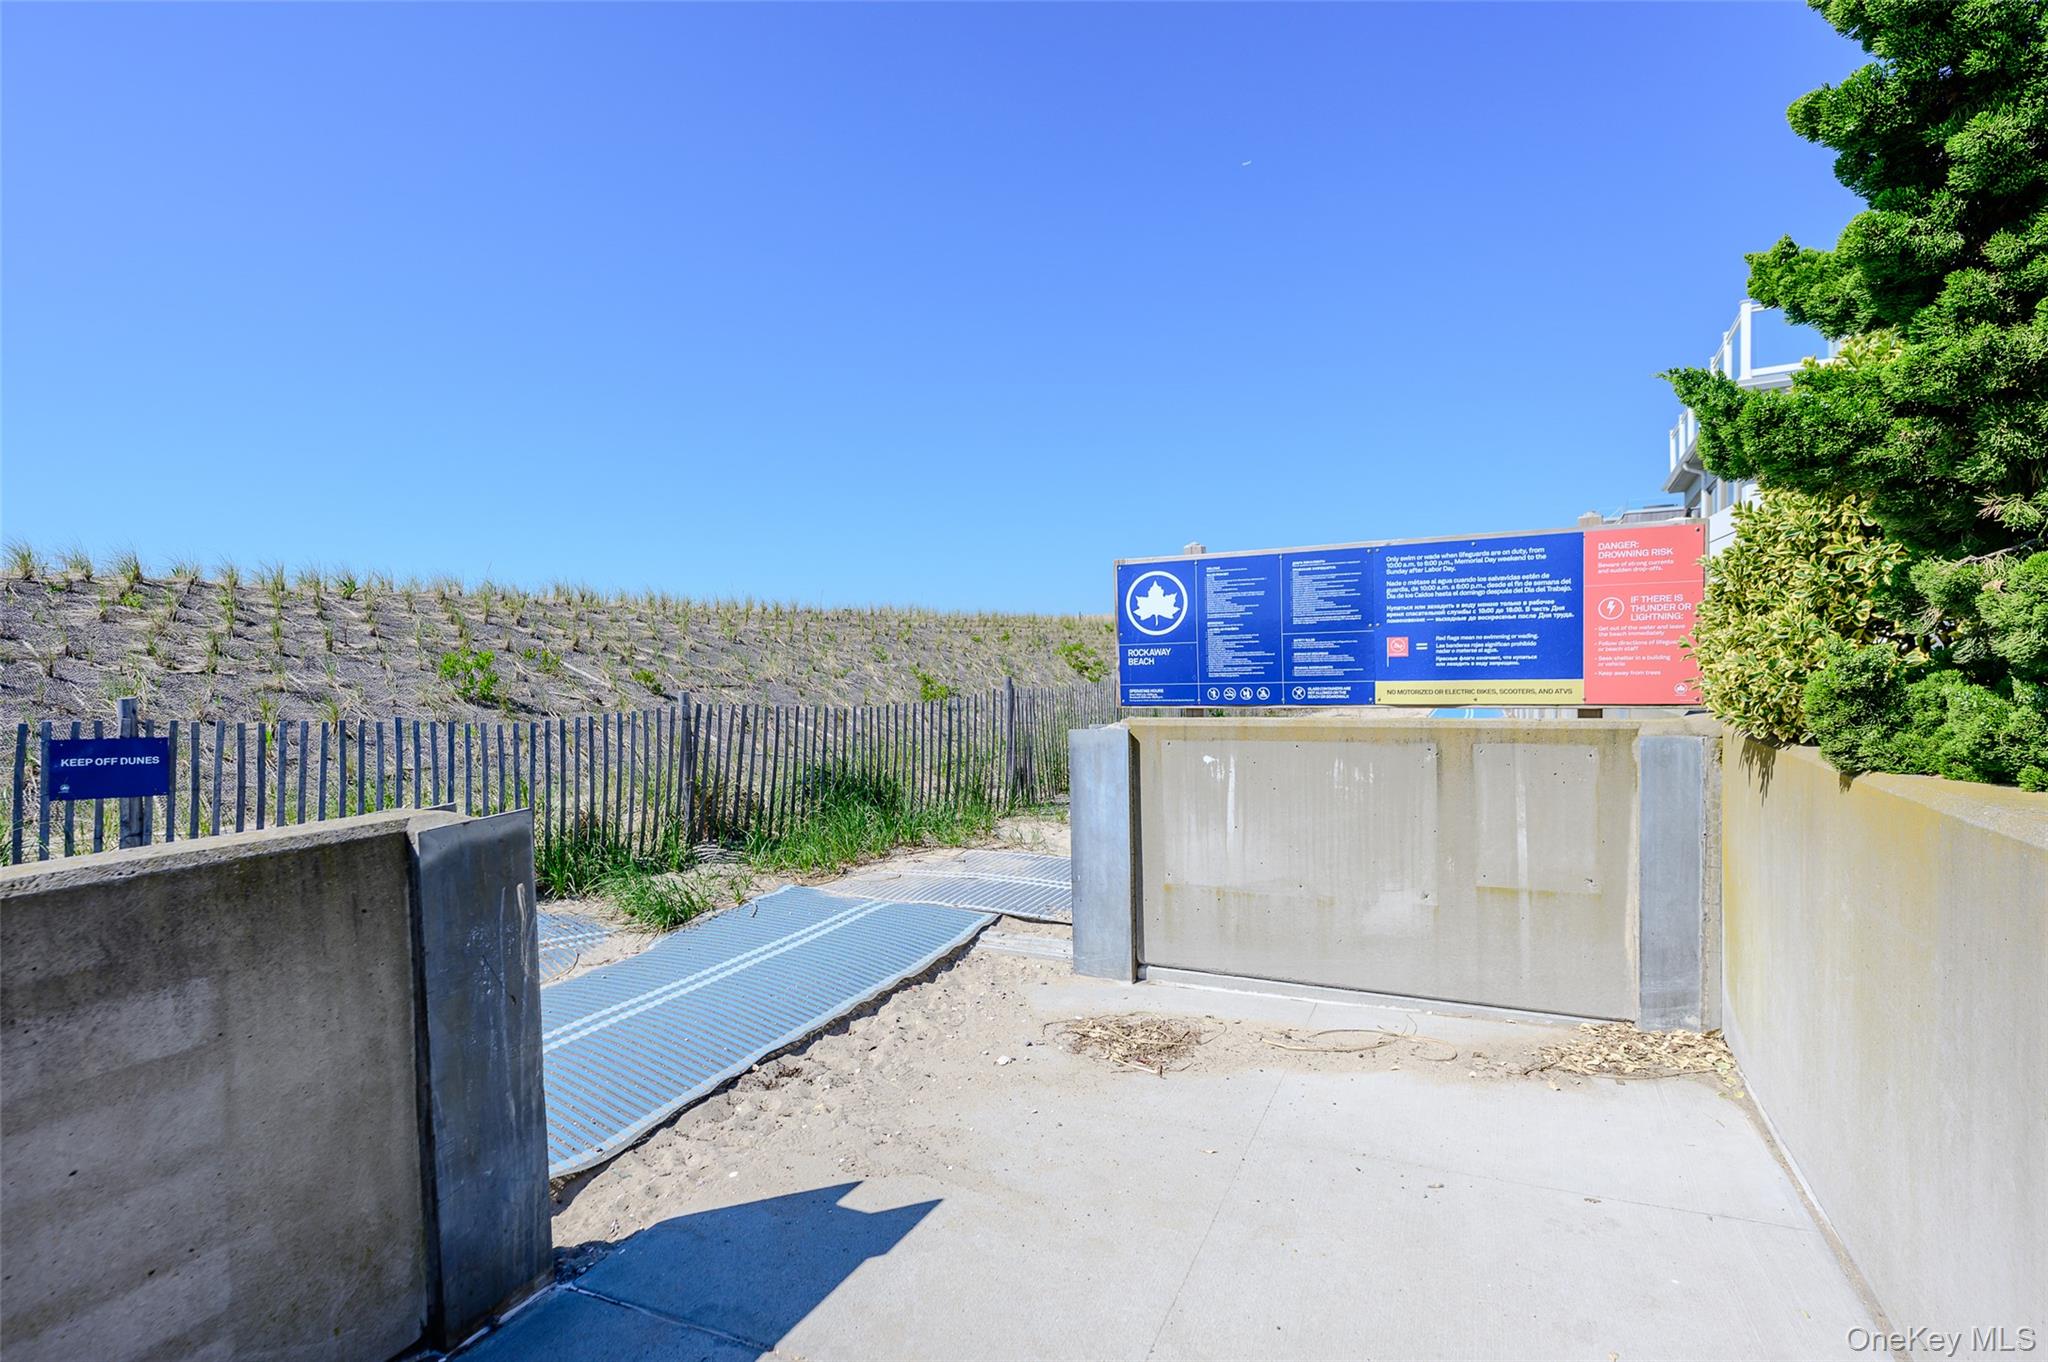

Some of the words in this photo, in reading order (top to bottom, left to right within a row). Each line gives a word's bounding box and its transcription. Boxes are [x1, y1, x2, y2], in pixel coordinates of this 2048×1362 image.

[1598, 541, 1639, 551] DANGER:
[1459, 550, 1489, 559] lifeguards
[1512, 548, 1527, 556] duty,
[1598, 549, 1648, 559] DROWNING
[1651, 547, 1673, 556] RISK
[1642, 594, 1671, 603] THERE
[1631, 603, 1676, 612] THUNDER
[1678, 602, 1691, 610] OR
[1631, 612, 1683, 621] LIGHTNING:
[1128, 648, 1171, 657] ROCKAWAY
[1128, 658, 1155, 666] BEACH
[61, 758, 93, 767] KEEP
[95, 758, 118, 766] OFF
[120, 756, 160, 766] DUNES
